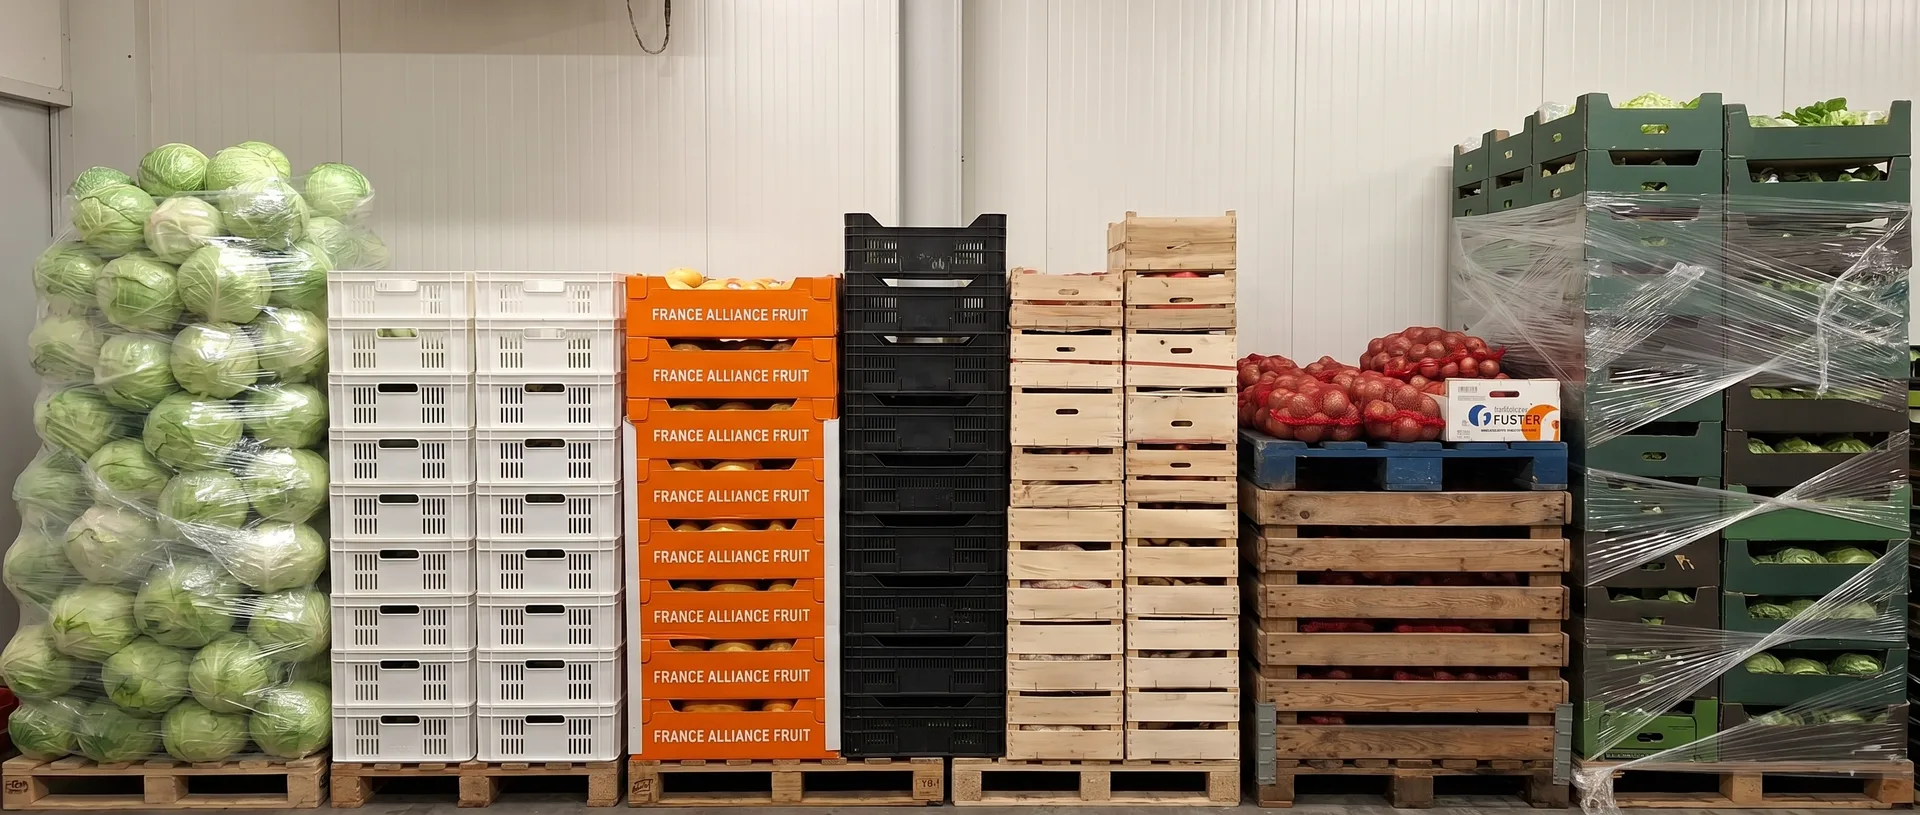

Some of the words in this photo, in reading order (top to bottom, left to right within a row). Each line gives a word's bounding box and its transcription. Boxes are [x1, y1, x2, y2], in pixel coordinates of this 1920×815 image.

[652, 308, 703, 321] FRANCE
[706, 308, 769, 321] ALLIANCE
[772, 308, 809, 321] FRUIT
[653, 369, 703, 382] FRANCE
[706, 369, 769, 382] ALLIANCE
[772, 369, 810, 382] FRUIT
[1494, 414, 1541, 425] FUSTER
[653, 429, 704, 442] FRANCE
[707, 429, 769, 442] ALLIANCE
[773, 429, 810, 442] FRUIT
[653, 489, 704, 503] FRANCE
[707, 489, 769, 503] ALLIANCE
[773, 489, 810, 503] FRUIT
[653, 549, 704, 563] FRANCE
[707, 549, 770, 563] ALLIANCE
[773, 549, 810, 563] FRUIT
[654, 609, 704, 623] FRANCE
[707, 609, 770, 623] ALLIANCE
[773, 609, 810, 623] FRUIT
[654, 669, 704, 683] FRANCE
[707, 669, 770, 683] ALLIANCE
[773, 669, 811, 683] FRUIT
[654, 728, 705, 743] FRANCE
[707, 728, 770, 743] ALLIANCE
[773, 728, 811, 743] FRUIT
